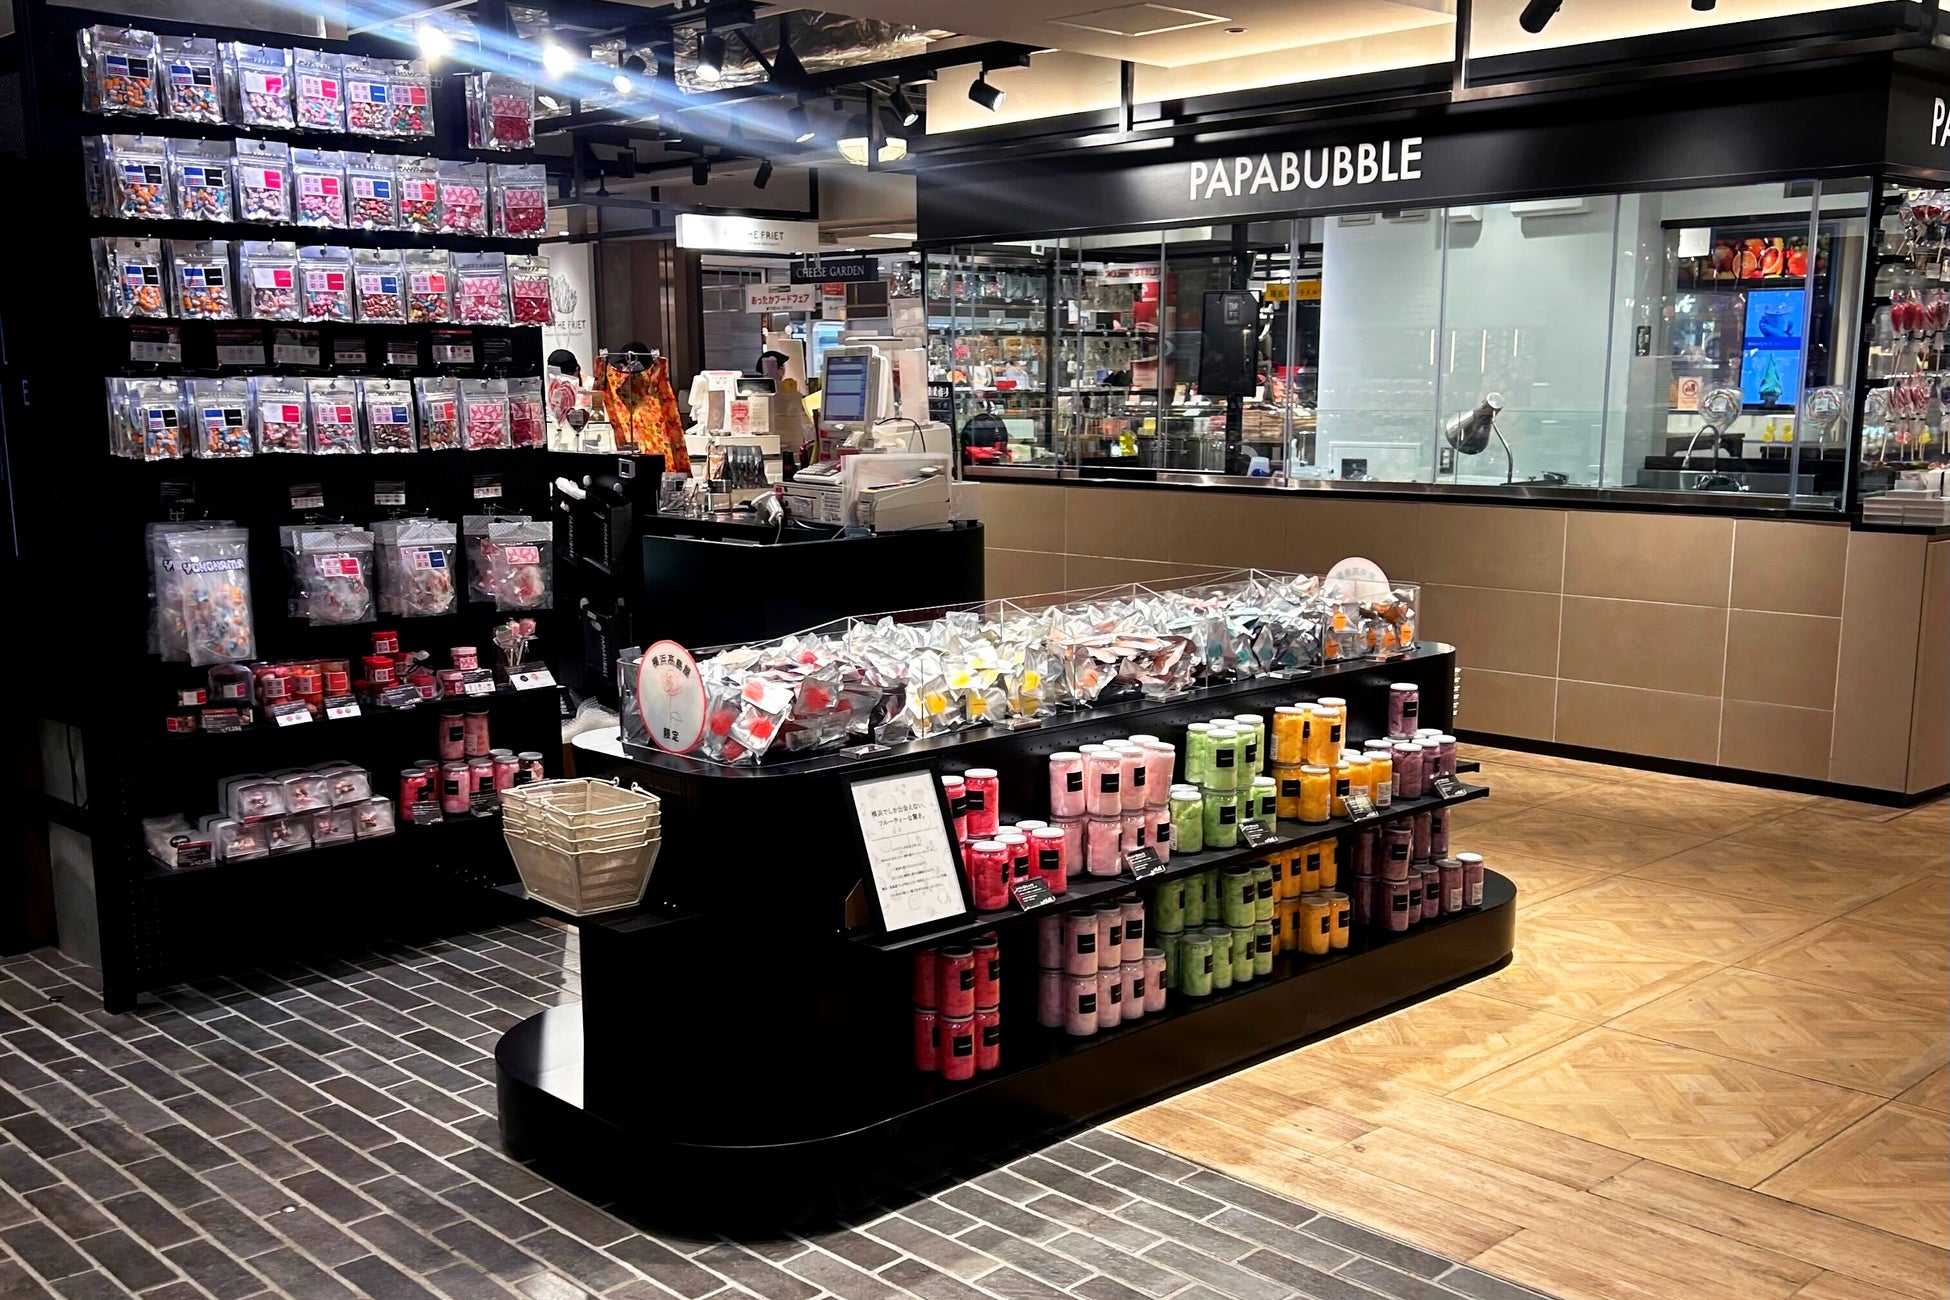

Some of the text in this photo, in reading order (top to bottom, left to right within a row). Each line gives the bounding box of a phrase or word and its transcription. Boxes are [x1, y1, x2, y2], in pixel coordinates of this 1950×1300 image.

[1189, 136, 1423, 201] PAPABUBBLE
[760, 230, 785, 241] FRIET
[796, 264, 865, 279] CHEESE GARDEN
[751, 294, 810, 306] あったかフードフェア
[567, 319, 586, 330] FRIET
[182, 558, 244, 575] YOKOHAMA
